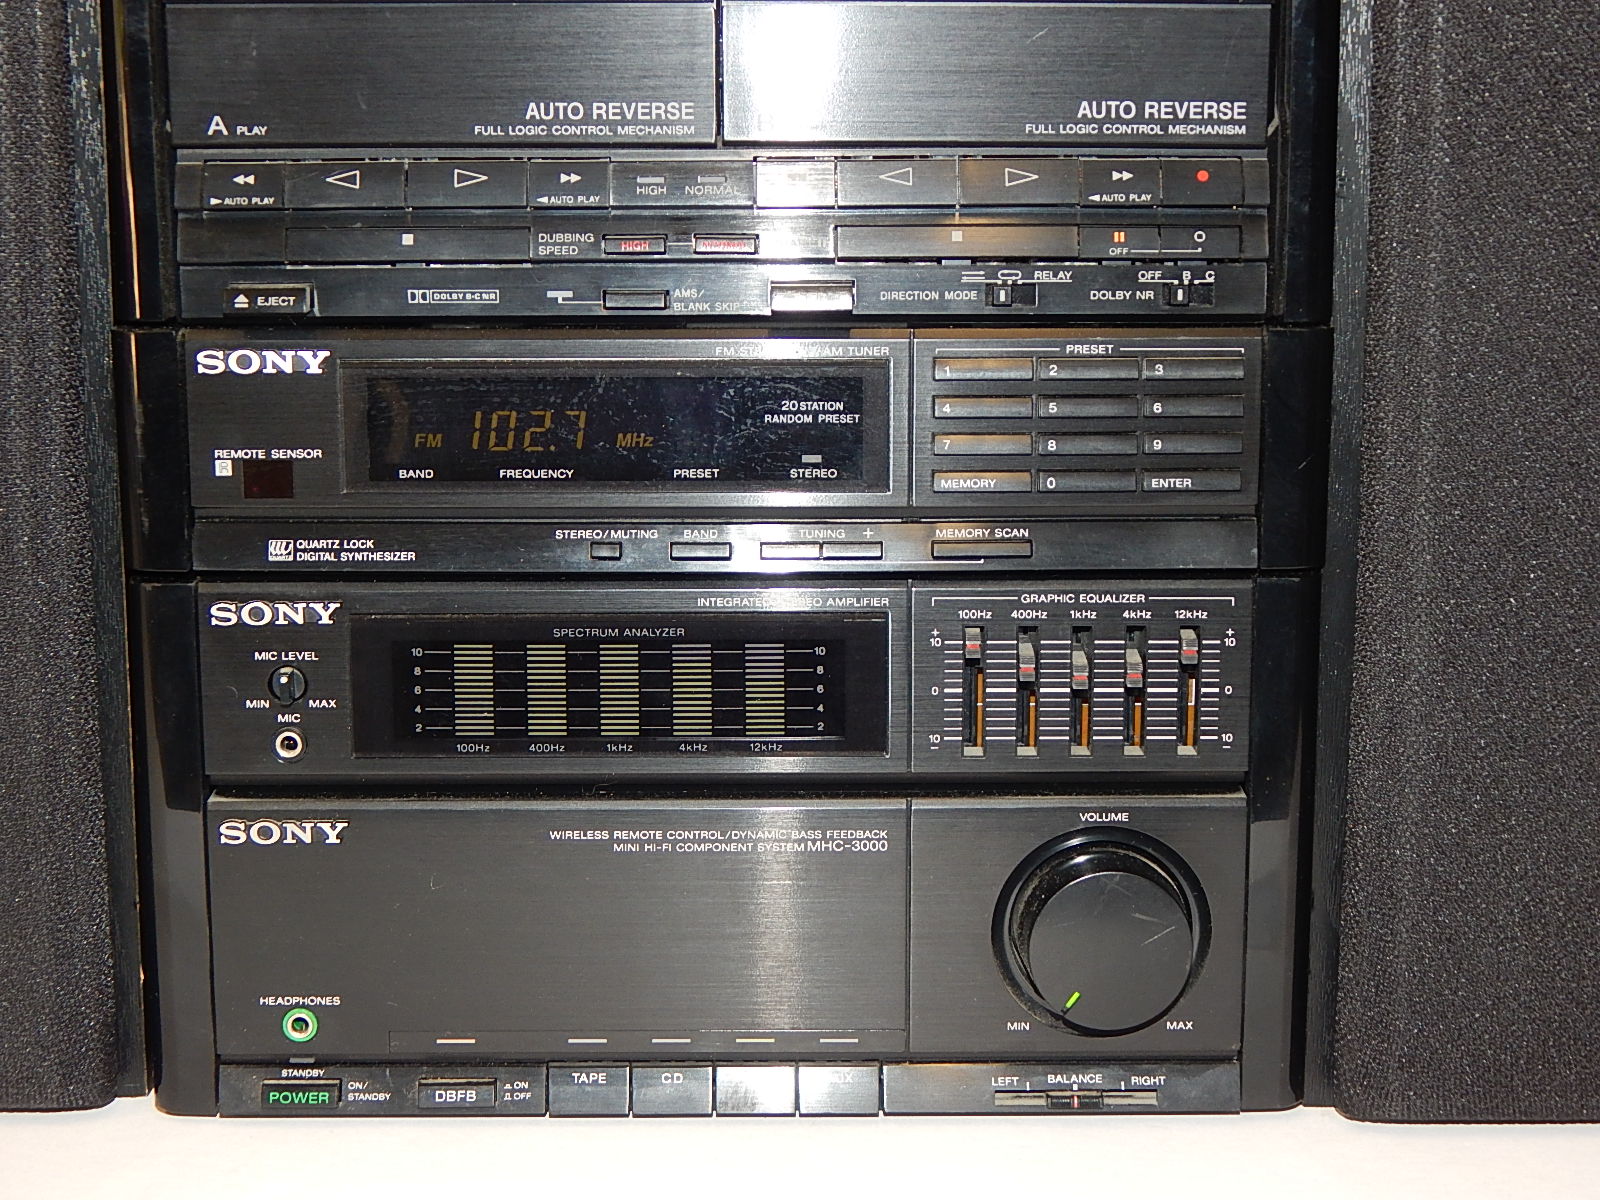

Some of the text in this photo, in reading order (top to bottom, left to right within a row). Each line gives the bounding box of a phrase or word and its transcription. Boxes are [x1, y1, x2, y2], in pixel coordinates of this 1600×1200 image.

[526, 102, 695, 120] AUTO REVERSE
[1077, 101, 1247, 119] AUTO REVERSE
[208, 116, 268, 136] A PLAY
[474, 125, 695, 136] FULL LOGIC CONTROL MECHANISM
[1025, 124, 1246, 135] FULL LOGIC CONTROL MECHANISM
[636, 185, 667, 195] HIGH
[685, 185, 741, 195] NORMAL
[224, 197, 275, 205] AUTO PLAY
[550, 195, 600, 204] AUTO PLAY
[1102, 194, 1152, 202] AUTO PLAY
[538, 233, 595, 243] DUBBING
[538, 246, 578, 256] SPEED
[621, 241, 649, 251] HIGH
[1109, 247, 1129, 255] OFF
[1034, 270, 1073, 280] RELAY
[1138, 271, 1215, 280] OFF B C
[673, 288, 705, 298] AMS/
[880, 291, 978, 300] DIRECTION MODE
[1090, 290, 1154, 300] DOLBY NR
[257, 297, 296, 306] EJECT
[673, 302, 740, 312] BLANK SKIP
[715, 347, 735, 356] FM
[848, 346, 889, 356] TUNER
[1066, 344, 1113, 354] PRESET
[196, 349, 331, 375] SONY
[944, 366, 951, 376] 1
[1049, 365, 1058, 376] 2
[1154, 364, 1164, 375] 3
[781, 401, 844, 411] 20 STATION
[942, 403, 951, 414] 4
[1048, 403, 1058, 413] 5
[1153, 402, 1162, 413] 6
[764, 414, 860, 424] RANDOM PRESET
[472, 411, 654, 451] 102.7 MHz
[415, 434, 442, 448] FM
[942, 440, 951, 450] 7
[1048, 439, 1056, 451] 8
[1153, 439, 1162, 450] 9
[214, 449, 322, 459] REMOTE SENSOR
[398, 469, 434, 479] BAND
[500, 469, 574, 479] FREQUENCY
[673, 469, 720, 479] PRESET
[790, 469, 838, 479] STEREO
[941, 478, 997, 488] MEMORY
[1046, 478, 1056, 489] 0
[1151, 478, 1192, 488] ENTER
[555, 529, 659, 540] STEREO/MUTING
[683, 529, 718, 539] BAND
[799, 528, 846, 539] TUNING
[935, 528, 1029, 538] MEMORY SCAN
[296, 539, 375, 549] QUARTZ LOCK
[296, 551, 338, 561] DIGITAL
[340, 551, 416, 561] SYNTHESIZER
[826, 597, 889, 607] AMPLIFIER
[1021, 594, 1146, 604] GRAPHIC EQUALIZER
[209, 601, 341, 626] SONY
[958, 610, 1208, 619] 100Hz 400Hz 1kHz 4kHz 12kHz
[553, 627, 685, 638] SPECTRUM ANALYZER
[929, 637, 942, 647] 10
[1223, 637, 1236, 647] 10
[254, 651, 319, 661] MIC LEVEL
[411, 647, 423, 657] 10
[814, 647, 826, 656] 10
[414, 667, 422, 676] 8
[816, 666, 824, 675] 8
[414, 685, 422, 695] 6
[816, 685, 824, 694] 6
[931, 686, 939, 696] 0
[1224, 685, 1233, 695] 0
[245, 699, 337, 709] MIN MAX
[816, 704, 825, 713] 4
[414, 705, 422, 714] 4
[277, 713, 301, 723] MIC
[415, 723, 423, 732] 2
[817, 722, 825, 731] 2
[928, 733, 941, 744] 10
[1220, 733, 1233, 743] 10
[456, 743, 783, 753] 100Hz 400Hz 1kHz 4kHz 12kHz
[1079, 812, 1130, 822] VOLUME
[219, 821, 349, 845] SONY
[549, 829, 888, 840] WIRELESS REMOTE CONTROL/DYNAMIC BASS FEEDBACK
[612, 840, 889, 852] MINI HI-FI COMPONENT SYSTEM MHC-3000
[259, 996, 341, 1006] HEADPHONES
[1007, 1021, 1030, 1031] MIN
[1166, 1021, 1194, 1030] MAX
[281, 1068, 325, 1078] STANDBY
[571, 1072, 607, 1084] TAPE
[661, 1072, 684, 1084] CD
[991, 1077, 1019, 1087] LEFT
[1047, 1074, 1103, 1084] BALANCE
[1131, 1076, 1166, 1086] RIGHT
[347, 1081, 369, 1090] ON/
[513, 1081, 529, 1090] ON
[269, 1091, 329, 1104] POWER
[347, 1092, 391, 1101] STANDBY
[435, 1090, 477, 1102] DBFB
[513, 1092, 532, 1100] OFF
